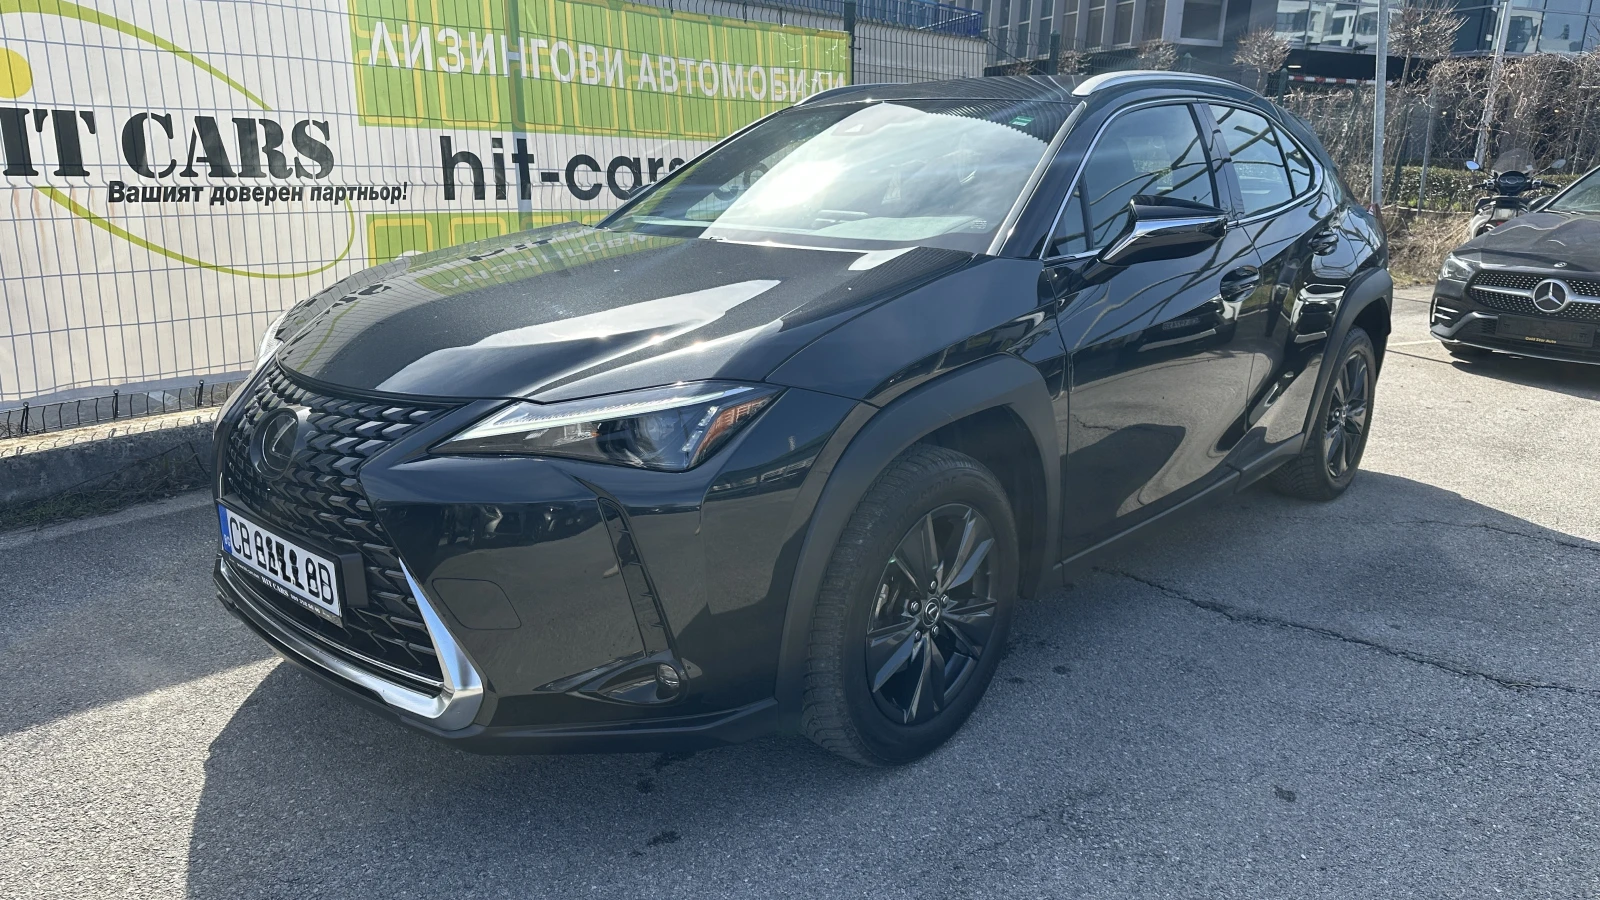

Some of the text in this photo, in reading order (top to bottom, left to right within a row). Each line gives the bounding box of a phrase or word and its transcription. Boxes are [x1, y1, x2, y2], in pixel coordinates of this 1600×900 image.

[368, 21, 625, 89] ЛИЗИНГОВИ
[121, 112, 335, 180] CARS
[108, 181, 407, 206] Вашият доверен партньор!
